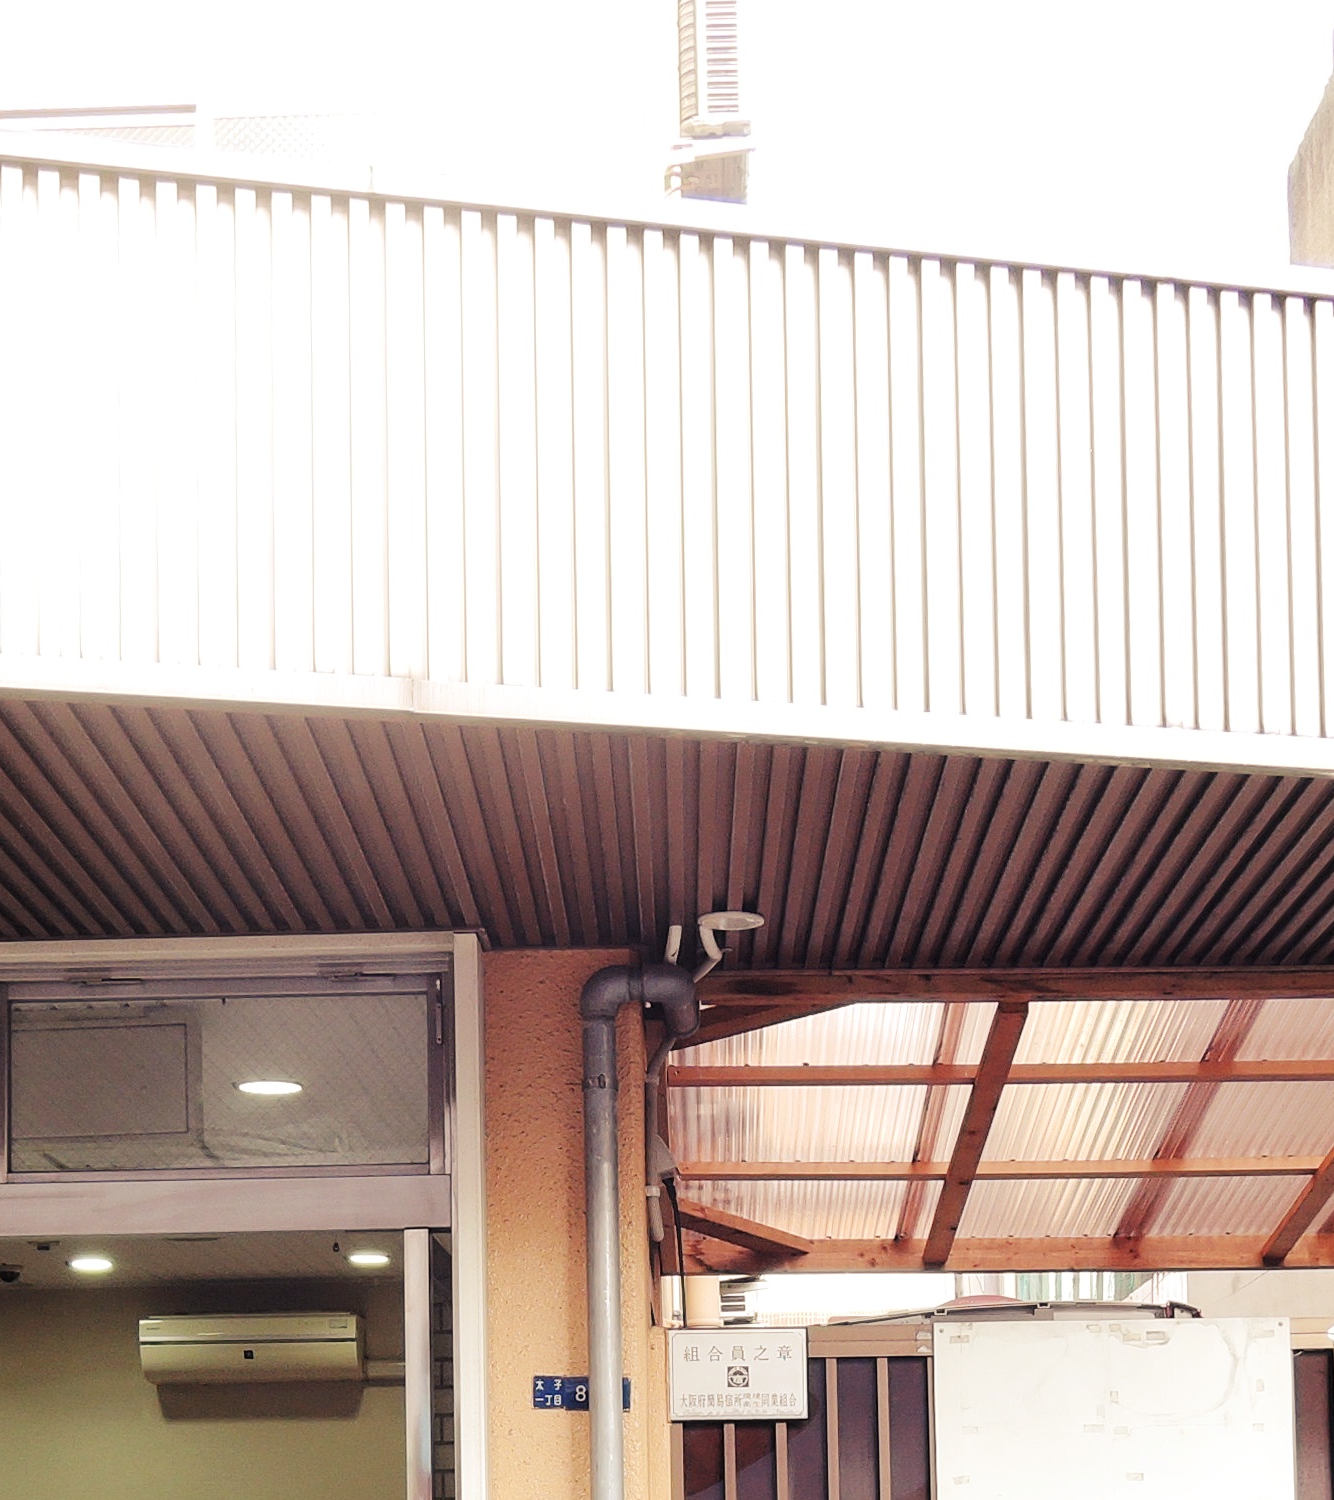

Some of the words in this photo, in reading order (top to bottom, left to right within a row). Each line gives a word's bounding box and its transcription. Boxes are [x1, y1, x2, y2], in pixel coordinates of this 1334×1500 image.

[683, 1345, 793, 1362] 組合員之章
[535, 1394, 562, 1406] 一丁目
[575, 1385, 587, 1402] 8
